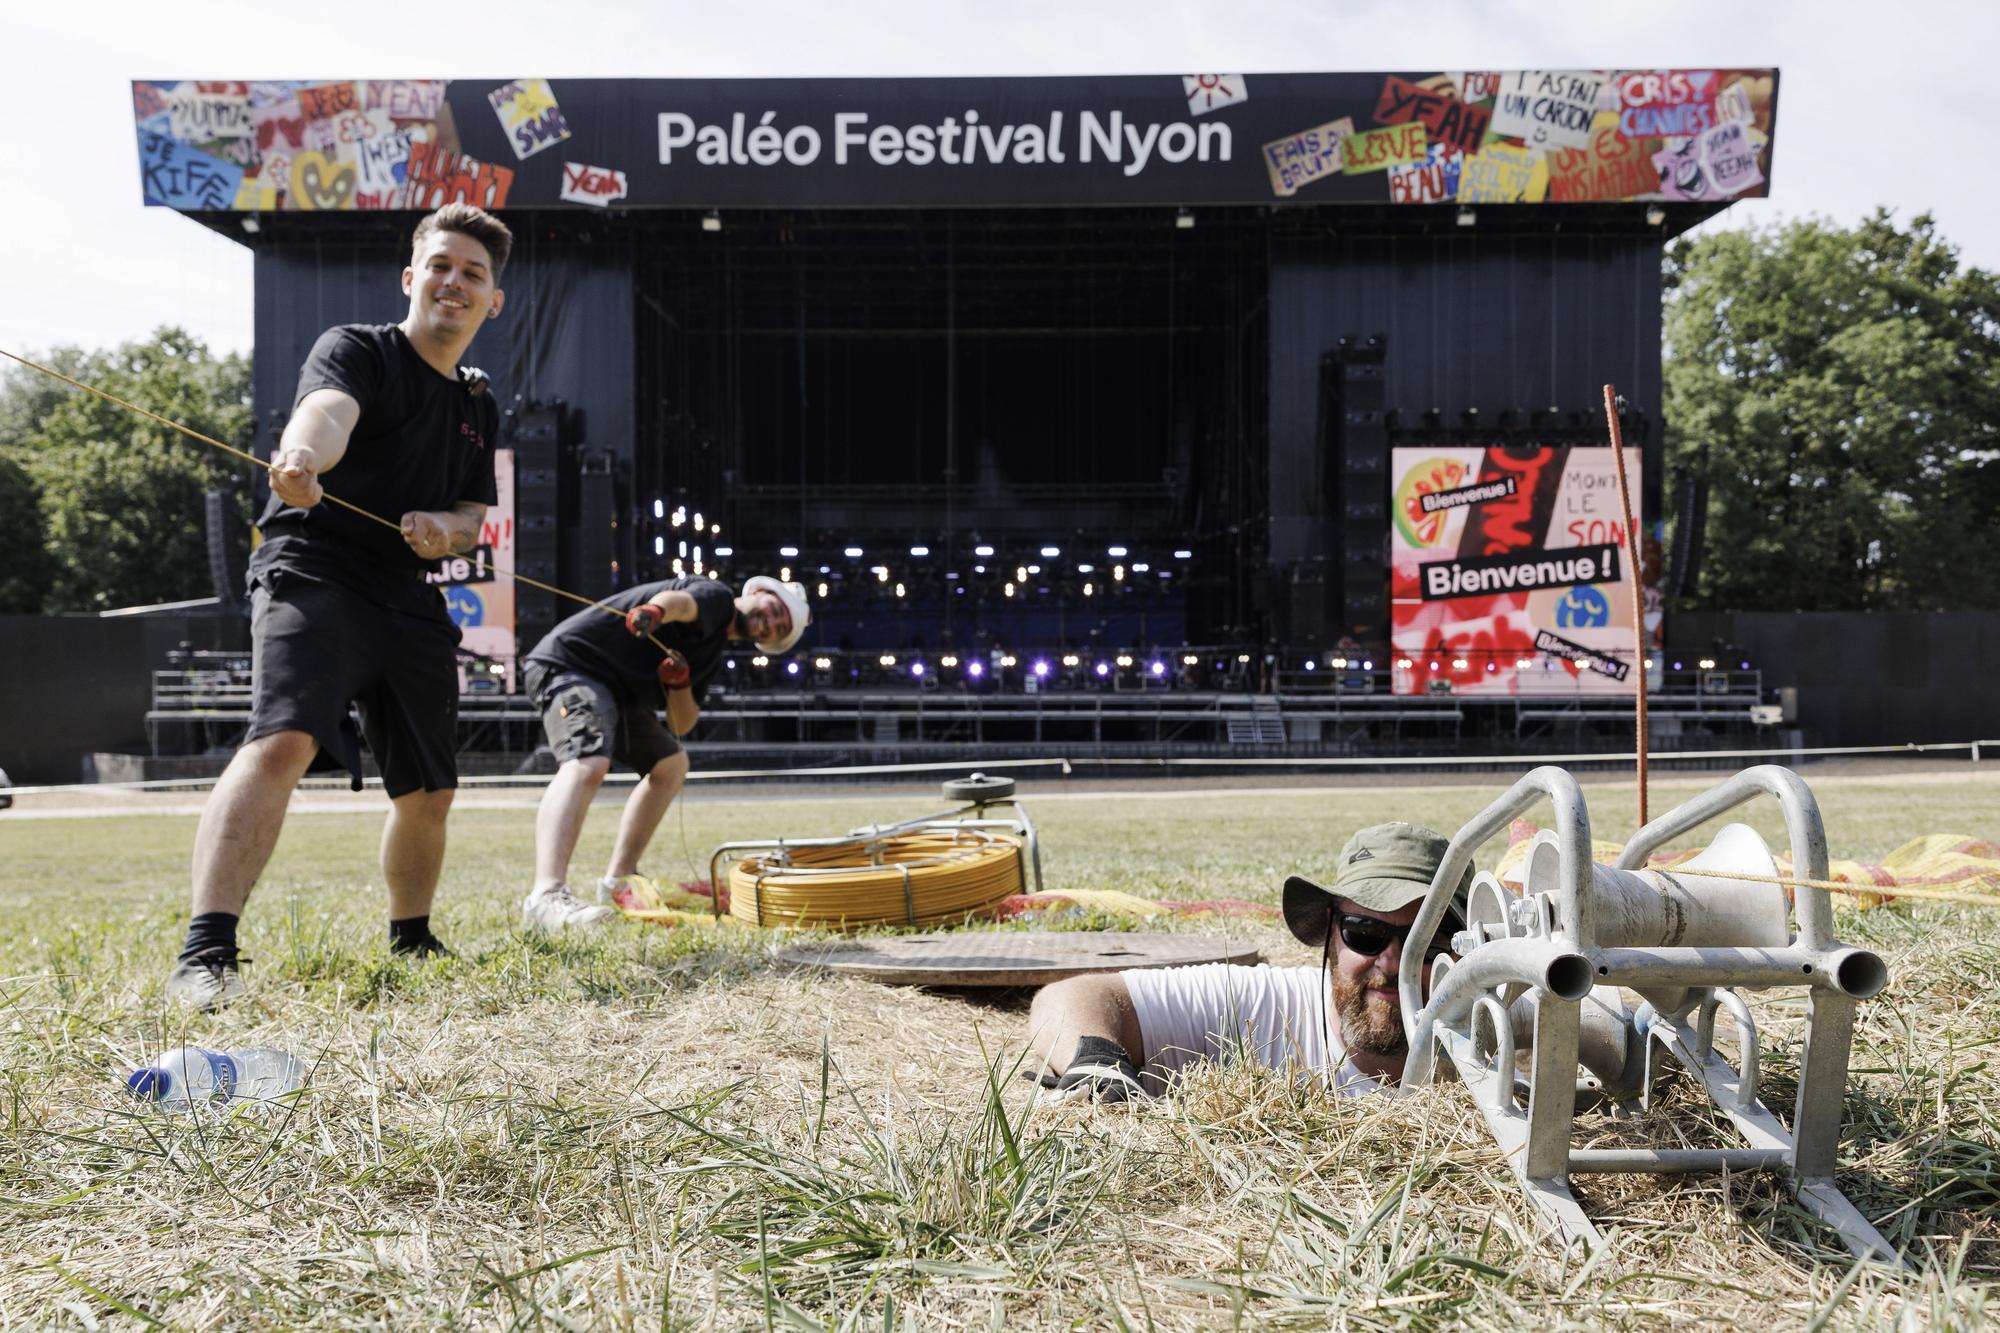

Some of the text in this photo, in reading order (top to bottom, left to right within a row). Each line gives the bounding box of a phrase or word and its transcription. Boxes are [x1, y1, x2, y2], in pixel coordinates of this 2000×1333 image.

[658, 109, 1232, 176] Paléo Festival Nyon
[1347, 126, 1425, 167] LOVE
[1423, 484, 1506, 511] Bienvenue
[1567, 494, 1597, 513] LE
[1427, 550, 1612, 596] Bienvenue !
